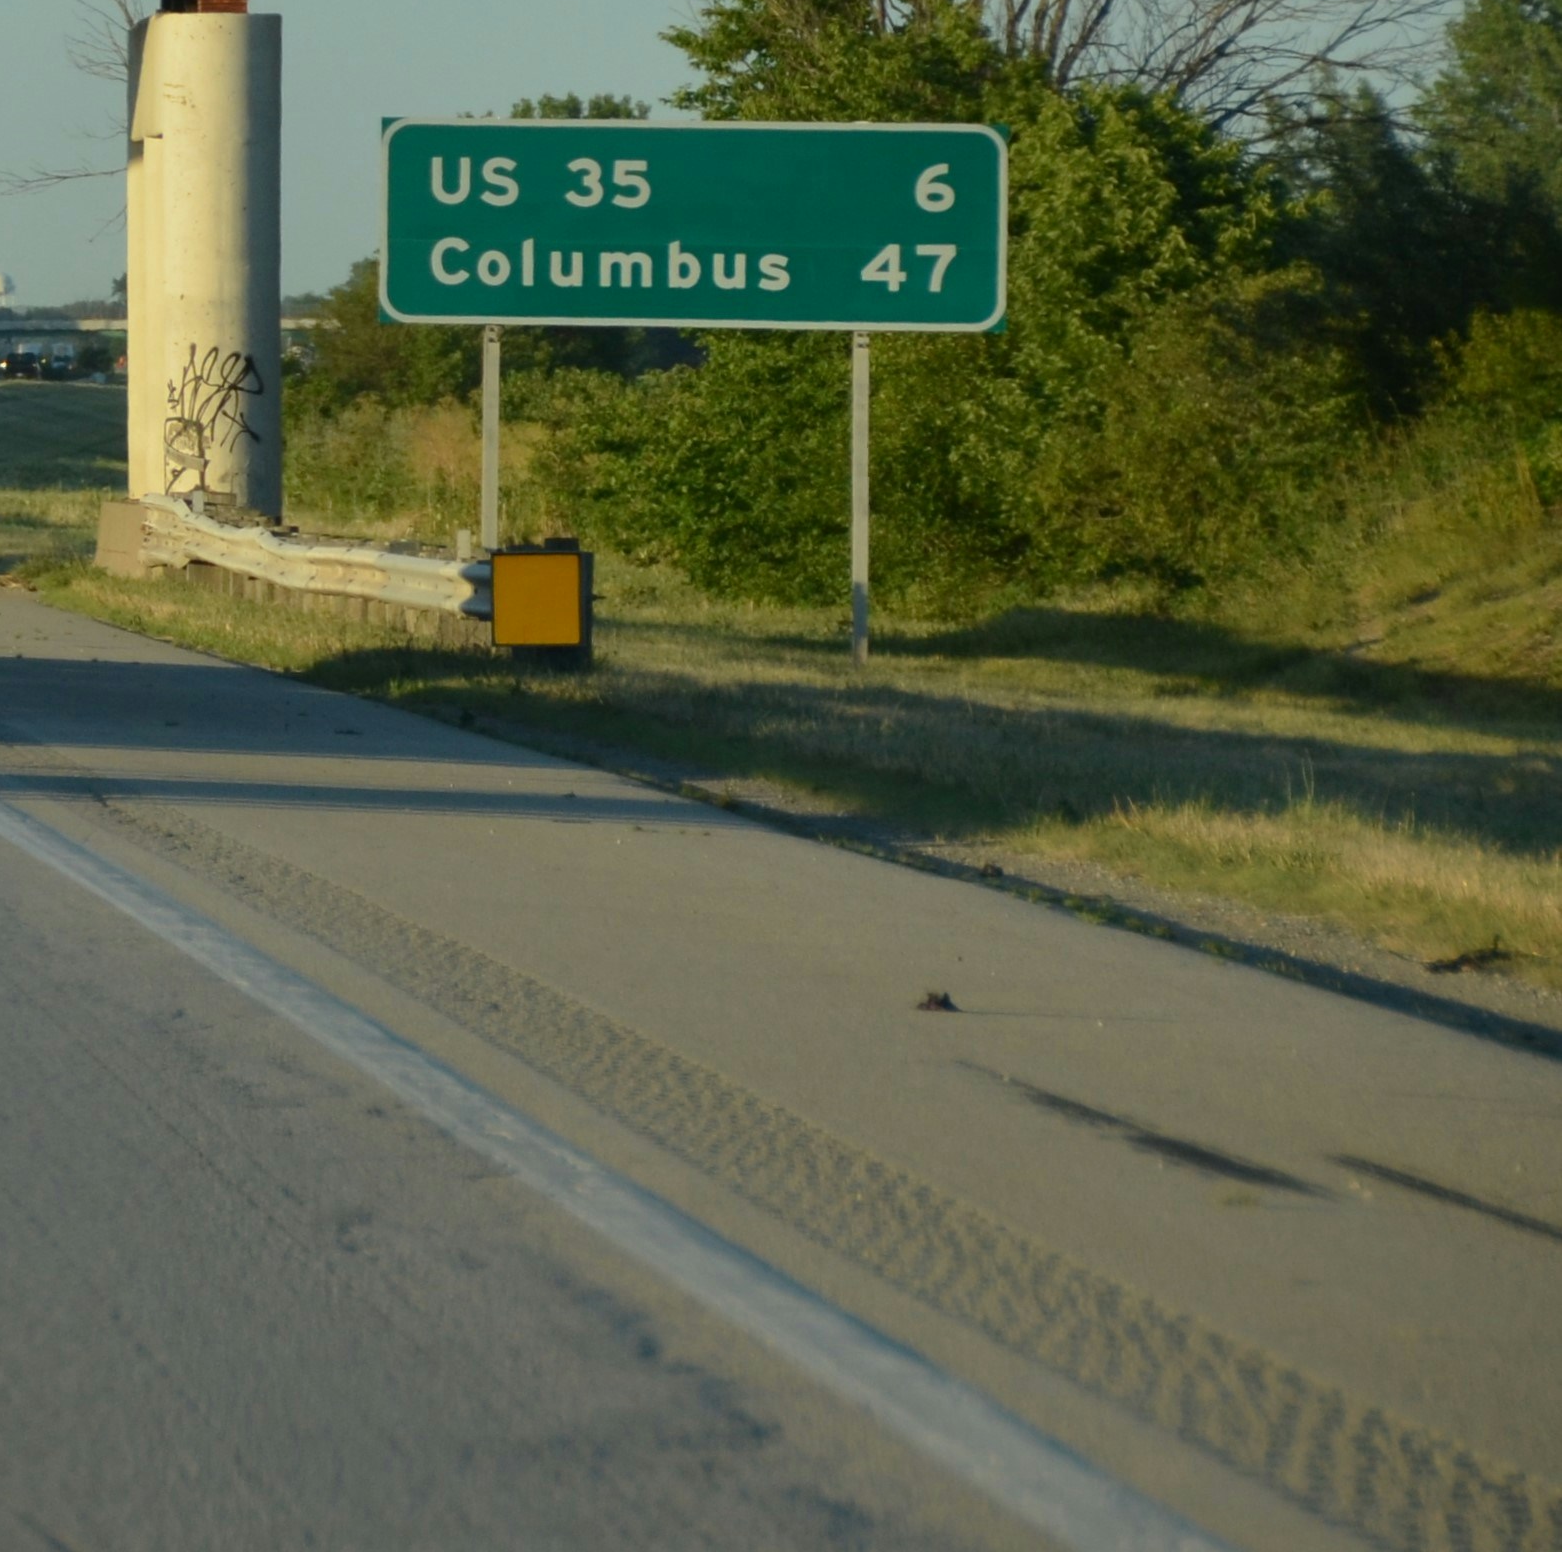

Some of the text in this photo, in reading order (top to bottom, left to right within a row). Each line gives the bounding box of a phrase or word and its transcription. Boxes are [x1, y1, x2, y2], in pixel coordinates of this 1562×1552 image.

[430, 156, 957, 213] US 35 6
[430, 236, 958, 293] Columbus 47
